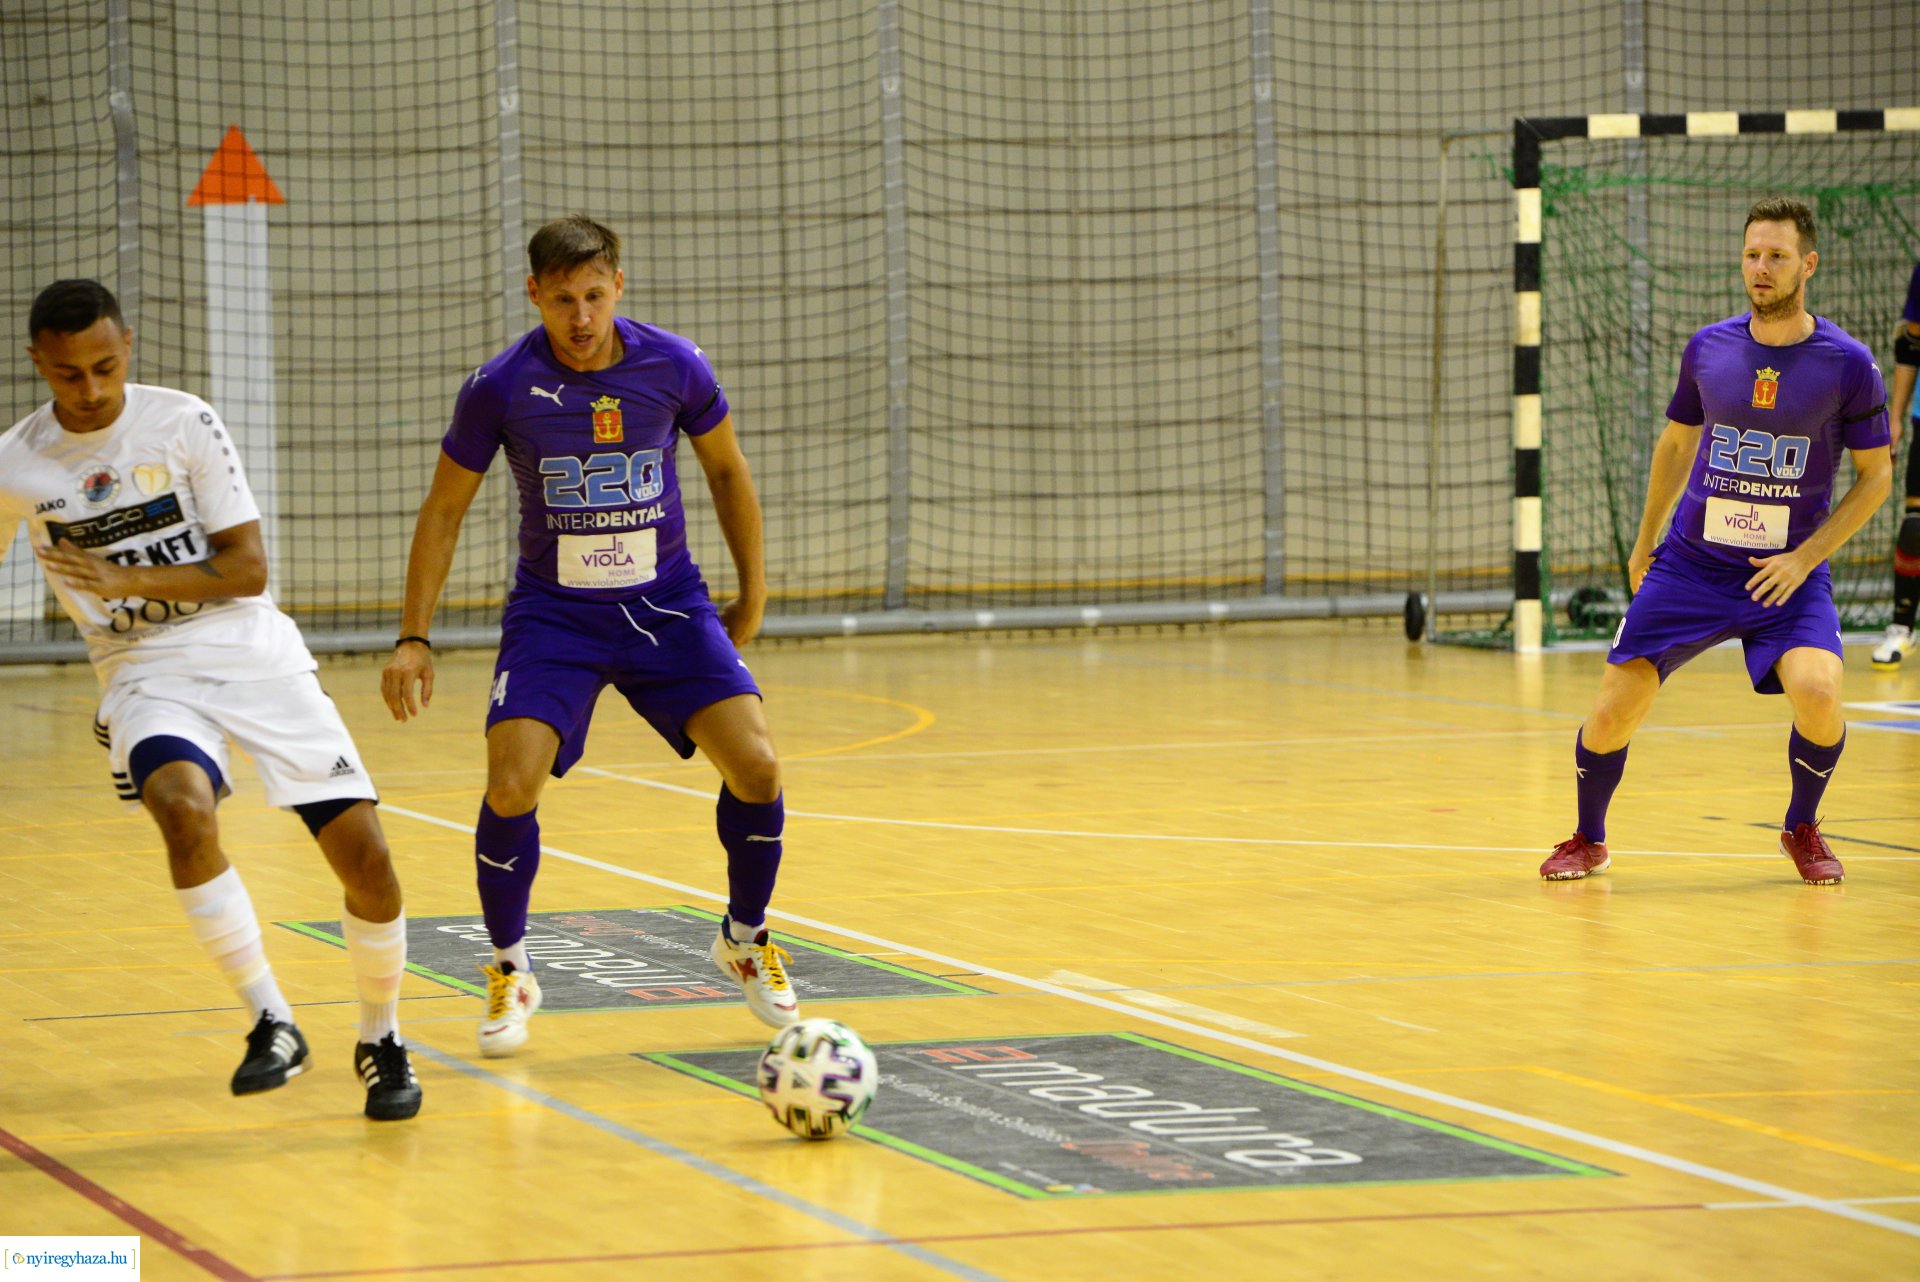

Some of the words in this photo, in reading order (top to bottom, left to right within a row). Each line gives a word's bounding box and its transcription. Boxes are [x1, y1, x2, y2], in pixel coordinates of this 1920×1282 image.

[1709, 423, 1810, 479] 220
[539, 448, 663, 508] 220
[1776, 466, 1801, 477] VOLT
[635, 482, 660, 500] VOLT
[1703, 473, 1801, 498] INTERDENTAL
[546, 503, 666, 529] INTERDENTAL
[1724, 515, 1766, 532] VIOLA
[1710, 535, 1780, 549] www.violahome.hu
[1744, 532, 1767, 541] HOME
[145, 529, 197, 565] KFT
[581, 553, 635, 568] VIOLA
[567, 573, 650, 587] www.violahome.hu
[608, 568, 636, 577] HOME
